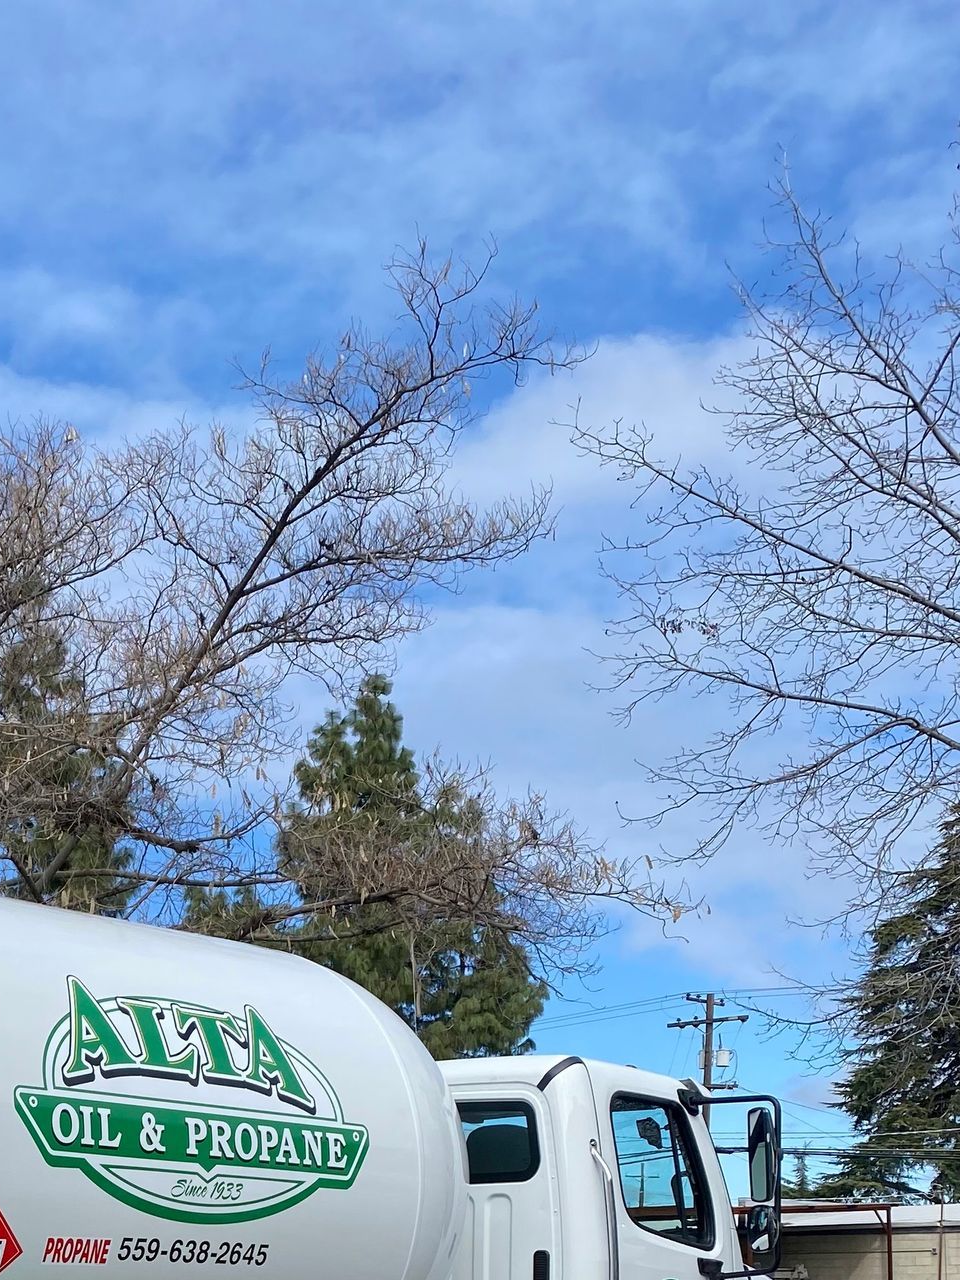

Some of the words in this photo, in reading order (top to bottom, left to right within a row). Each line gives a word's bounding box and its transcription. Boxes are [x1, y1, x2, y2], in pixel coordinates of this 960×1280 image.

[61, 974, 317, 1115] ALTA
[51, 1102, 123, 1149] OIL
[138, 1112, 167, 1154] &
[184, 1116, 349, 1170] PROPANE
[170, 1179, 208, 1198] Since
[209, 1180, 244, 1201] 1933
[42, 1237, 112, 1265] PROPANE
[117, 1237, 270, 1267] 559-638-2645
